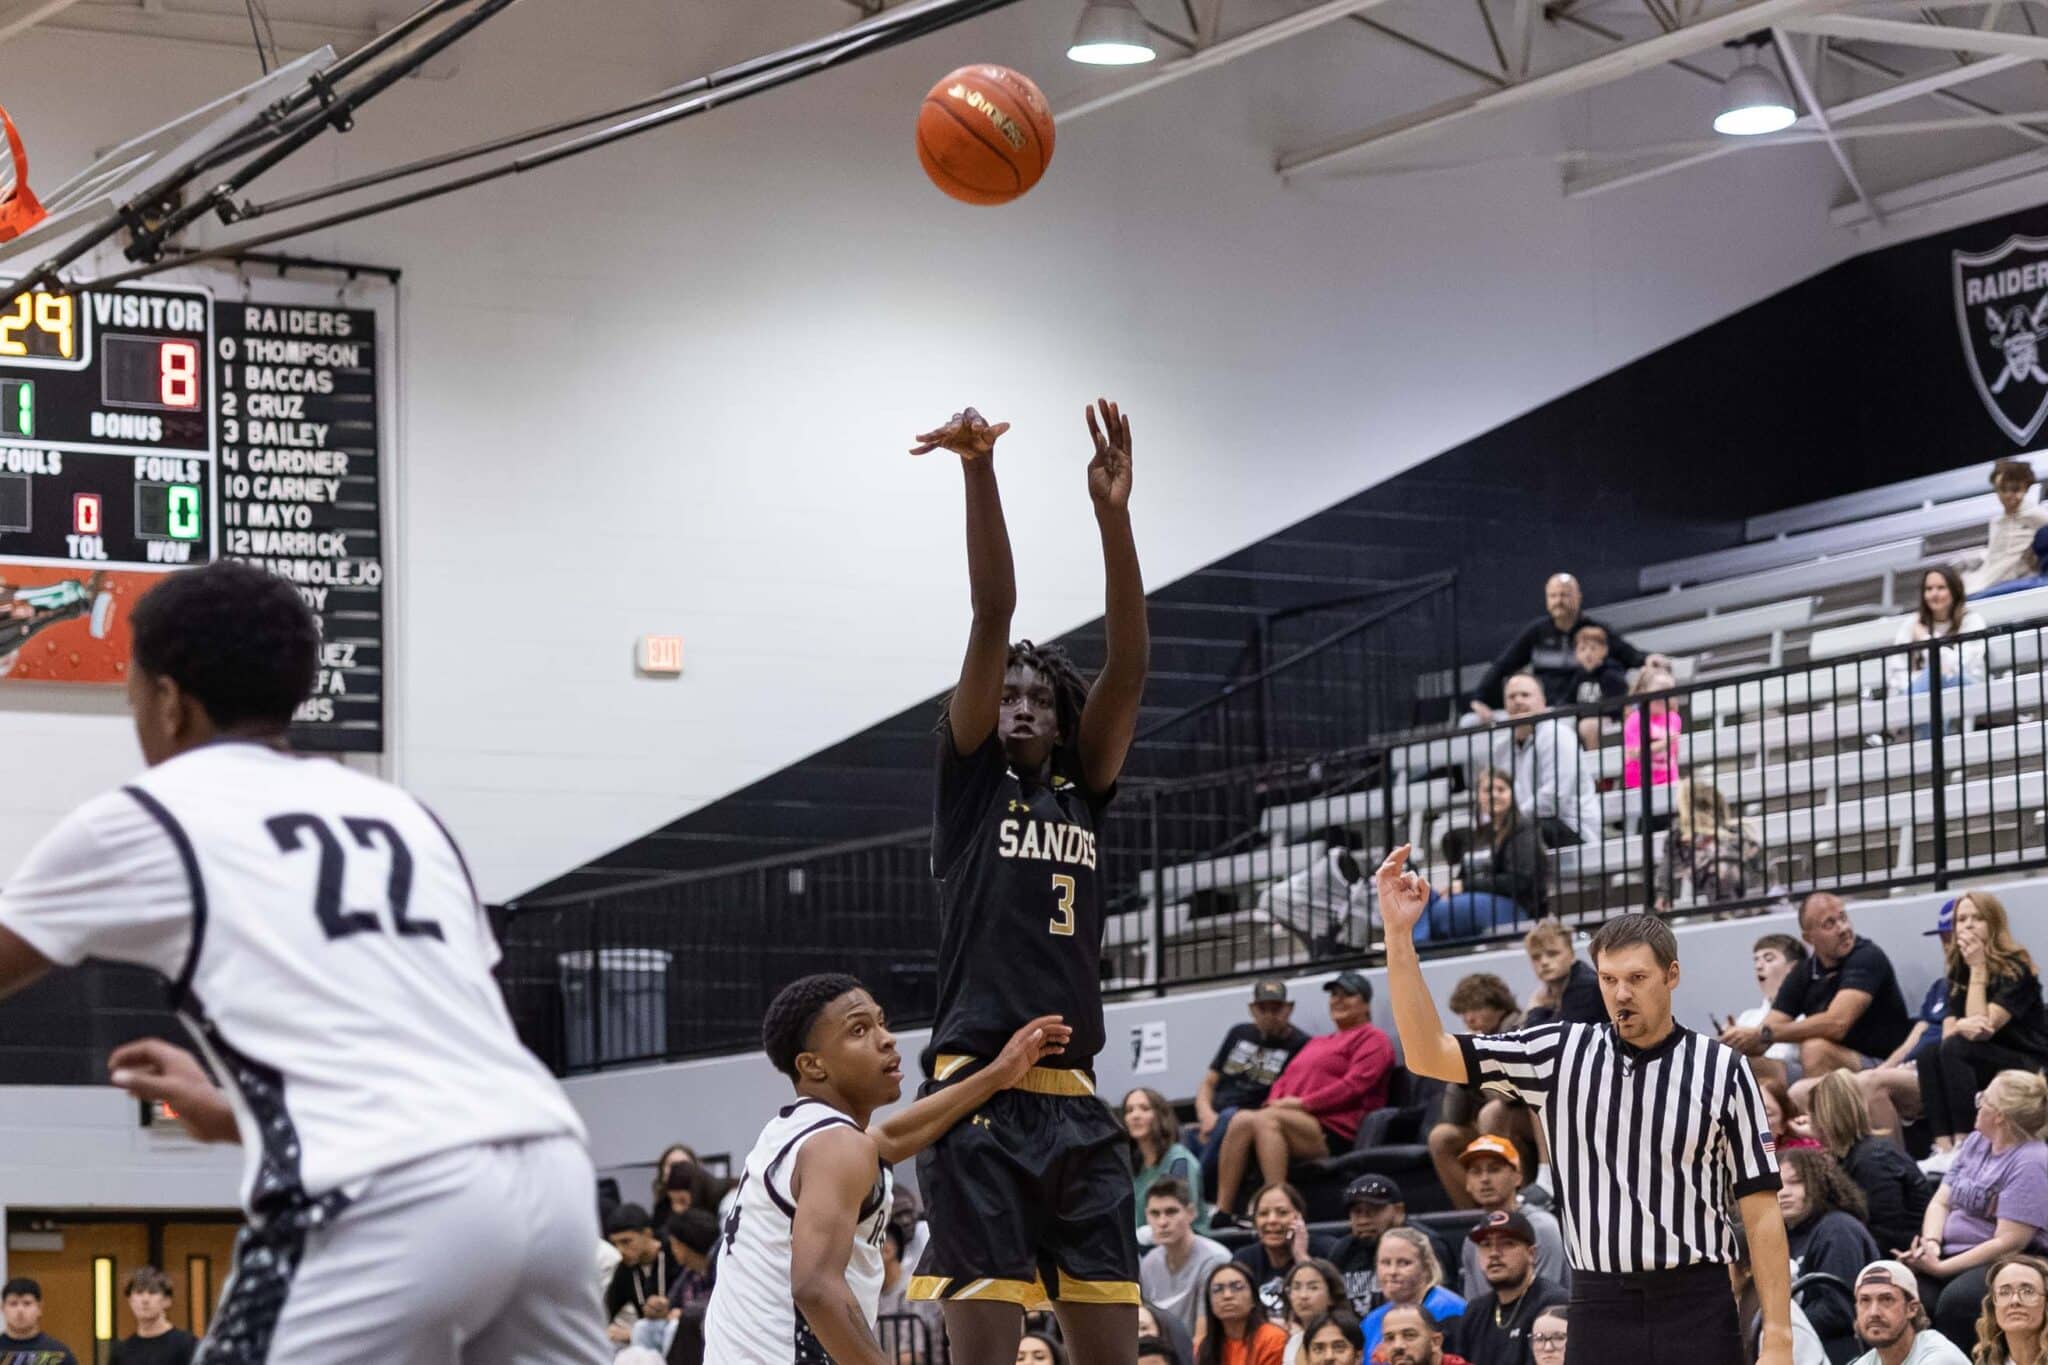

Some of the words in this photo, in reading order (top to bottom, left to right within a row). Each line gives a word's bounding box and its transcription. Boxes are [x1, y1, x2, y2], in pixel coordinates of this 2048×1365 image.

[94, 294, 204, 332] VISITOR
[245, 307, 351, 335] RAIDERS
[219, 337, 236, 360] 0
[243, 338, 359, 367] THOMPSON
[161, 342, 198, 407] 8
[224, 364, 233, 388] 1
[245, 366, 334, 393] BACCAS
[18, 383, 32, 436] 1
[221, 392, 237, 416] 2
[247, 394, 305, 419] CRUZ
[91, 412, 162, 441] BONUS
[223, 419, 239, 443] 3
[248, 421, 328, 447] BAILEY
[134, 456, 200, 483] FOULS
[222, 446, 239, 470] 4
[248, 449, 348, 475] GARDNER
[224, 474, 249, 499] 10
[253, 475, 340, 502] CARNEY
[78, 497, 98, 533] 0
[168, 485, 199, 538] 0
[224, 502, 241, 526] 11
[248, 502, 312, 528] MAYO
[66, 535, 108, 560] TOL
[147, 540, 190, 562] WON
[226, 529, 249, 554] 12
[250, 530, 348, 558] WARRICK
[264, 811, 446, 940] 22
[1049, 873, 1075, 936] 3
